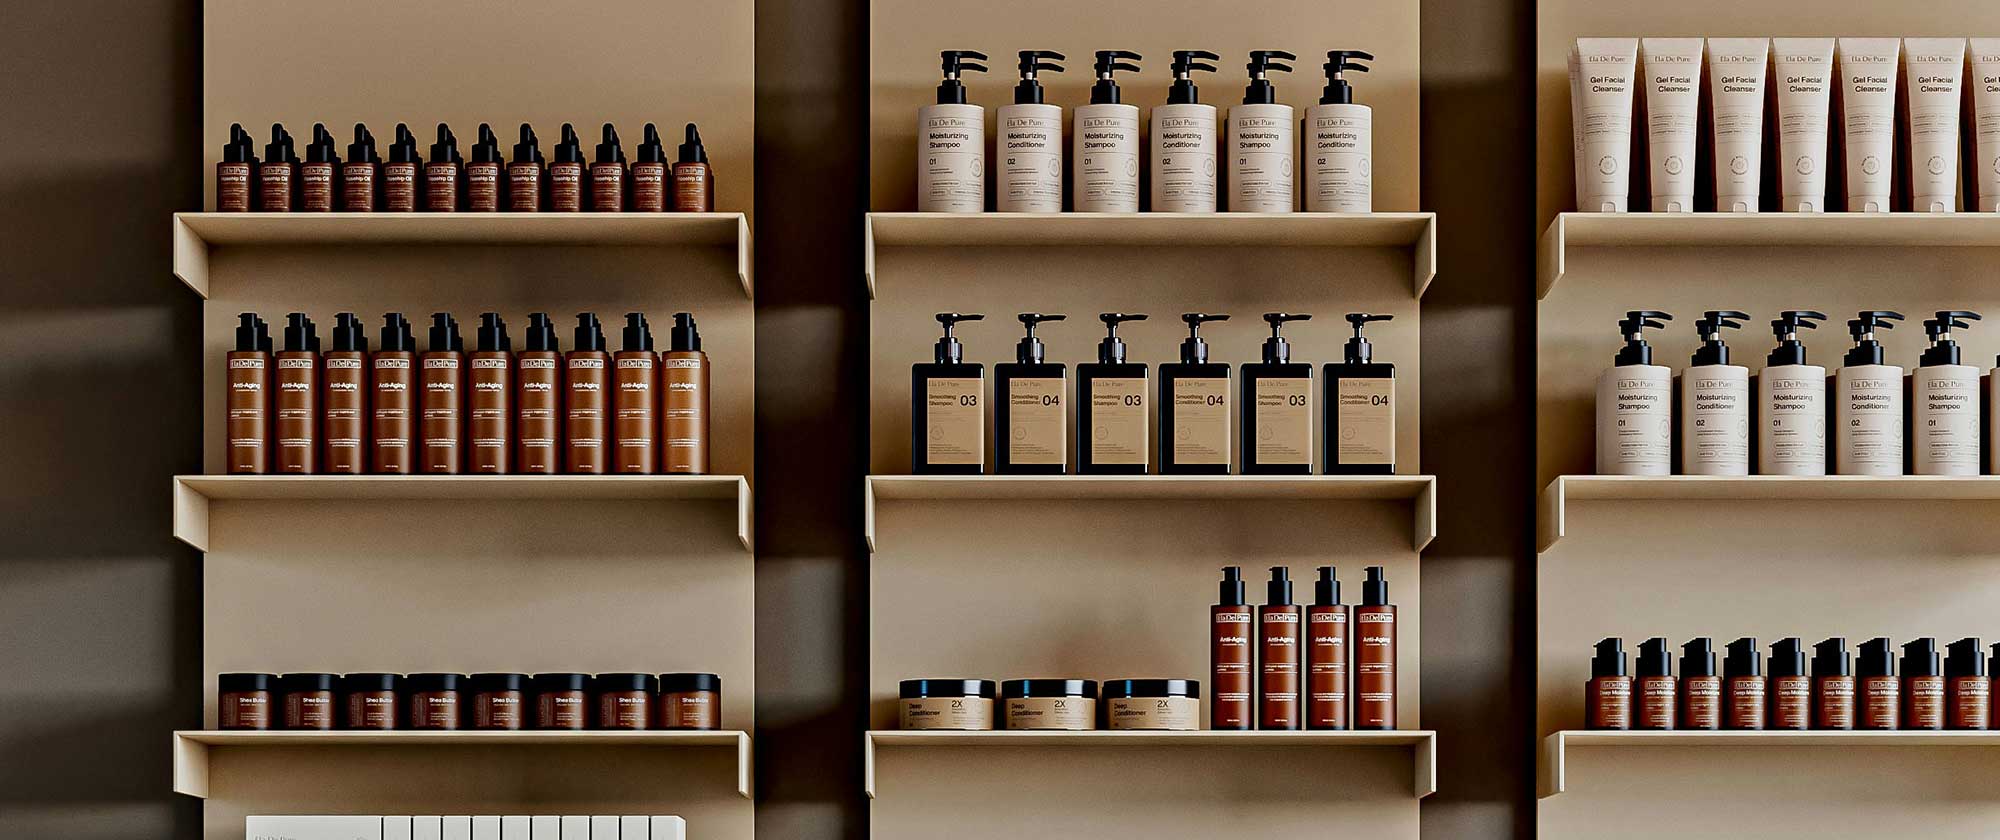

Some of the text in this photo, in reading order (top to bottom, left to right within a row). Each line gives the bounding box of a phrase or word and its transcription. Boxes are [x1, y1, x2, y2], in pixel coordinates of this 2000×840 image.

[1590, 76, 1626, 84] Gel Facial
[1656, 76, 1691, 84] Gel Facial
[1722, 76, 1757, 84] Gel Facial
[1788, 76, 1823, 84] Gel Facial
[1853, 76, 1888, 84] Gel Facial
[1918, 76, 1954, 84] Gel Facial
[1984, 76, 1997, 84] Gel
[960, 395, 977, 406] 03
[1043, 395, 1059, 406] 04
[1125, 395, 1142, 406] 03
[1207, 395, 1224, 406] 04
[1289, 395, 1306, 406] 03
[1372, 395, 1388, 406] 04
[1618, 394, 1658, 402] Moisturizing
[1697, 394, 1736, 402] Moisturizing
[1774, 394, 1813, 402] Moisturizing
[1852, 394, 1891, 402] Moisturizing
[1929, 394, 1968, 402] Moisturizing
[952, 700, 962, 708] 2X
[1054, 700, 1065, 708] 2X
[1157, 700, 1168, 708] 2X
